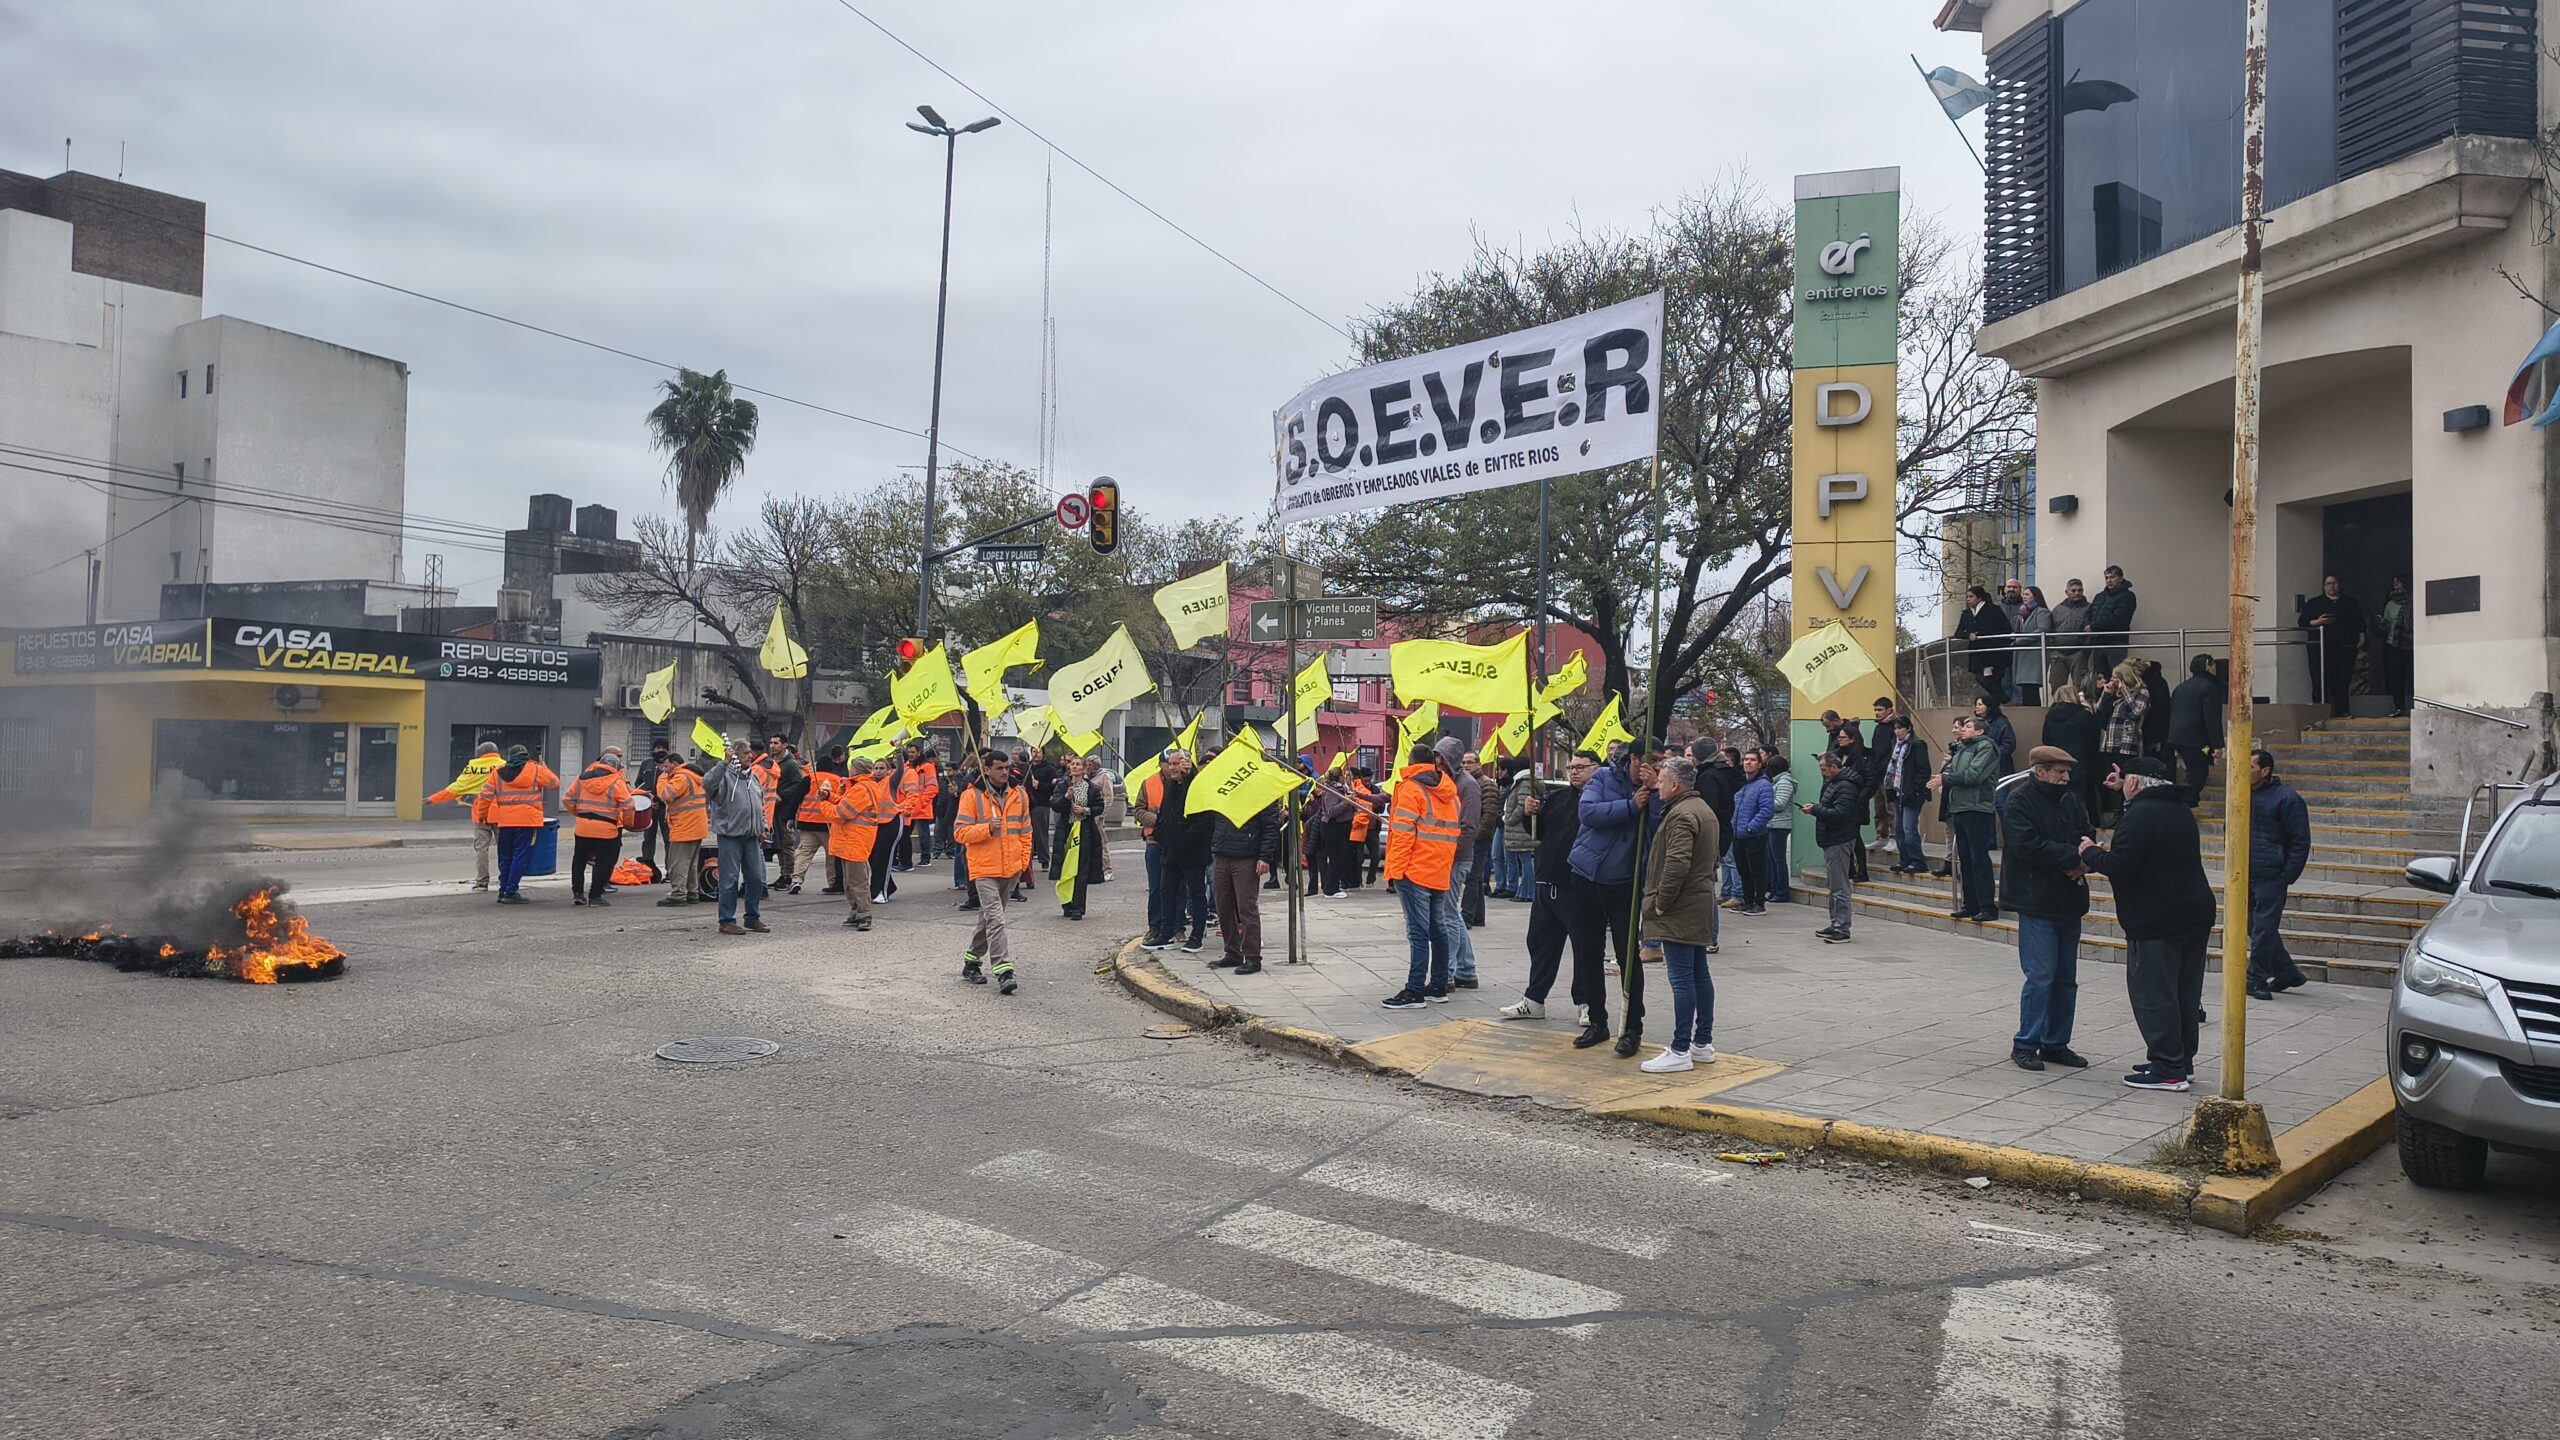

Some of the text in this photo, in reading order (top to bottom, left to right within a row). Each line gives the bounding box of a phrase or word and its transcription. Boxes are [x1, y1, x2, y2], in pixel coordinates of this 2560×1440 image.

[1804, 283, 1888, 300] entrerios
[1284, 328, 1651, 486] S.O.E.V.E.R
[1312, 490, 1321, 503] de
[1321, 482, 1355, 502] OBREROS
[1355, 480, 1362, 495] Y
[1364, 469, 1420, 494] EMPLEADOS
[1420, 462, 1462, 484] VIALES
[1465, 460, 1480, 477] de
[1484, 451, 1526, 474] ENTRE
[1528, 446, 1560, 466] RIOS
[982, 550, 1038, 561] LOPEZ Y PLANES
[1306, 602, 1371, 616] Vicente Lopez
[1306, 615, 1345, 629] y Planes
[17, 630, 96, 651] REPUESTOS
[103, 625, 154, 647] CASA
[234, 625, 333, 651] CASA
[1306, 628, 1373, 638] 0 50
[440, 641, 569, 666] REPUESTOS
[497, 667, 568, 683] 4589894
